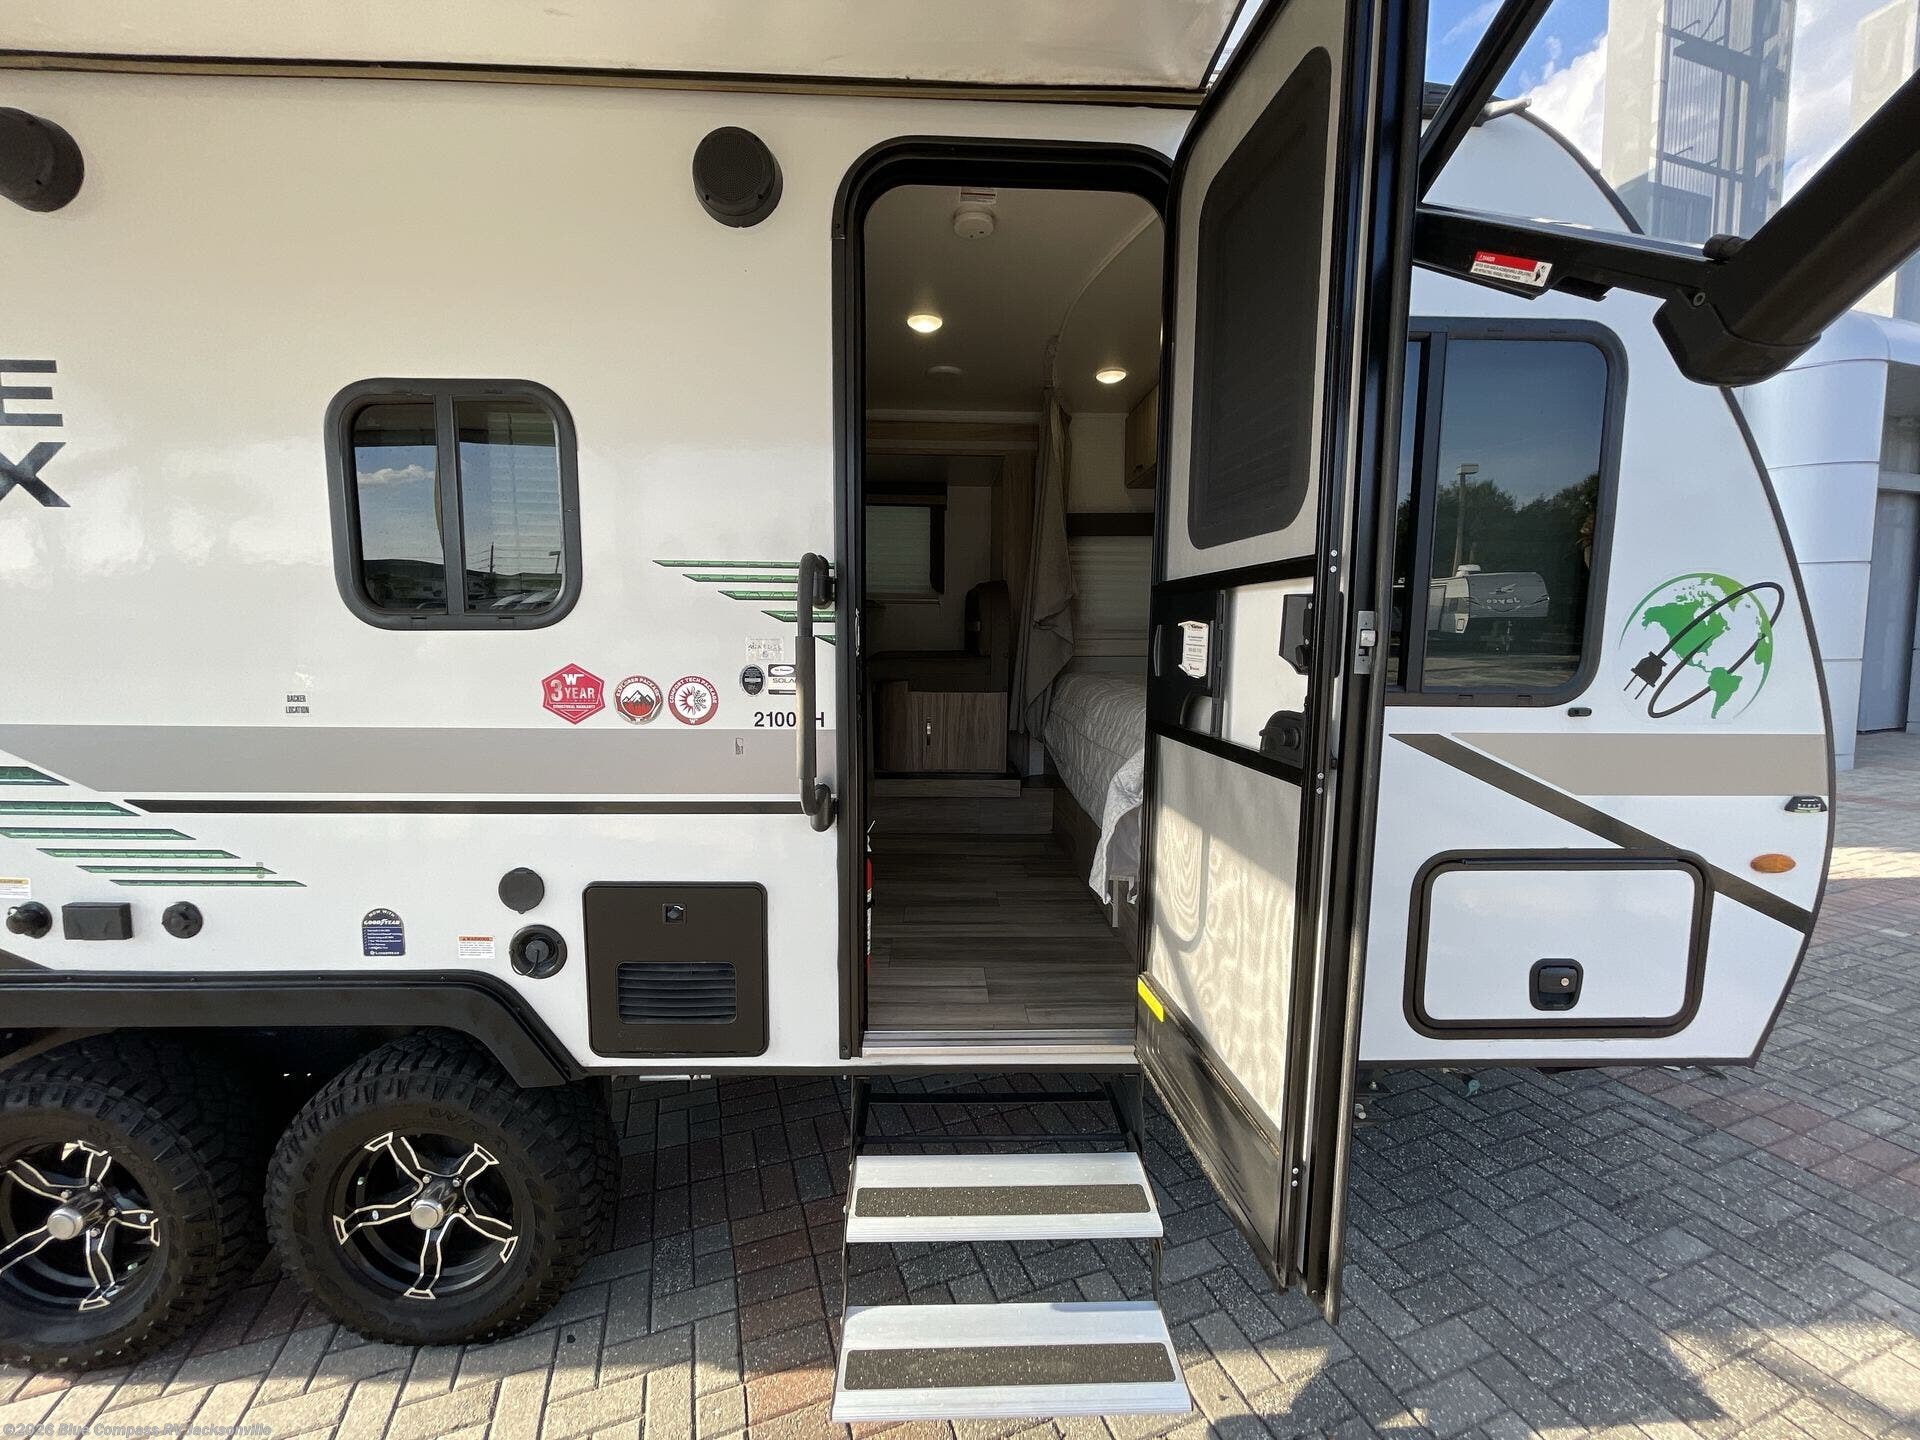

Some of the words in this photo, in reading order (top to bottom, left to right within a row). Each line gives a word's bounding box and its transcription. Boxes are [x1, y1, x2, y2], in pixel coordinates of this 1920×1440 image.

[0, 359, 63, 427] E
[0, 442, 71, 507] X
[550, 679, 564, 702] 3
[564, 687, 596, 699] YEAR
[285, 706, 310, 714] LOCATION
[754, 711, 825, 728] 2100H
